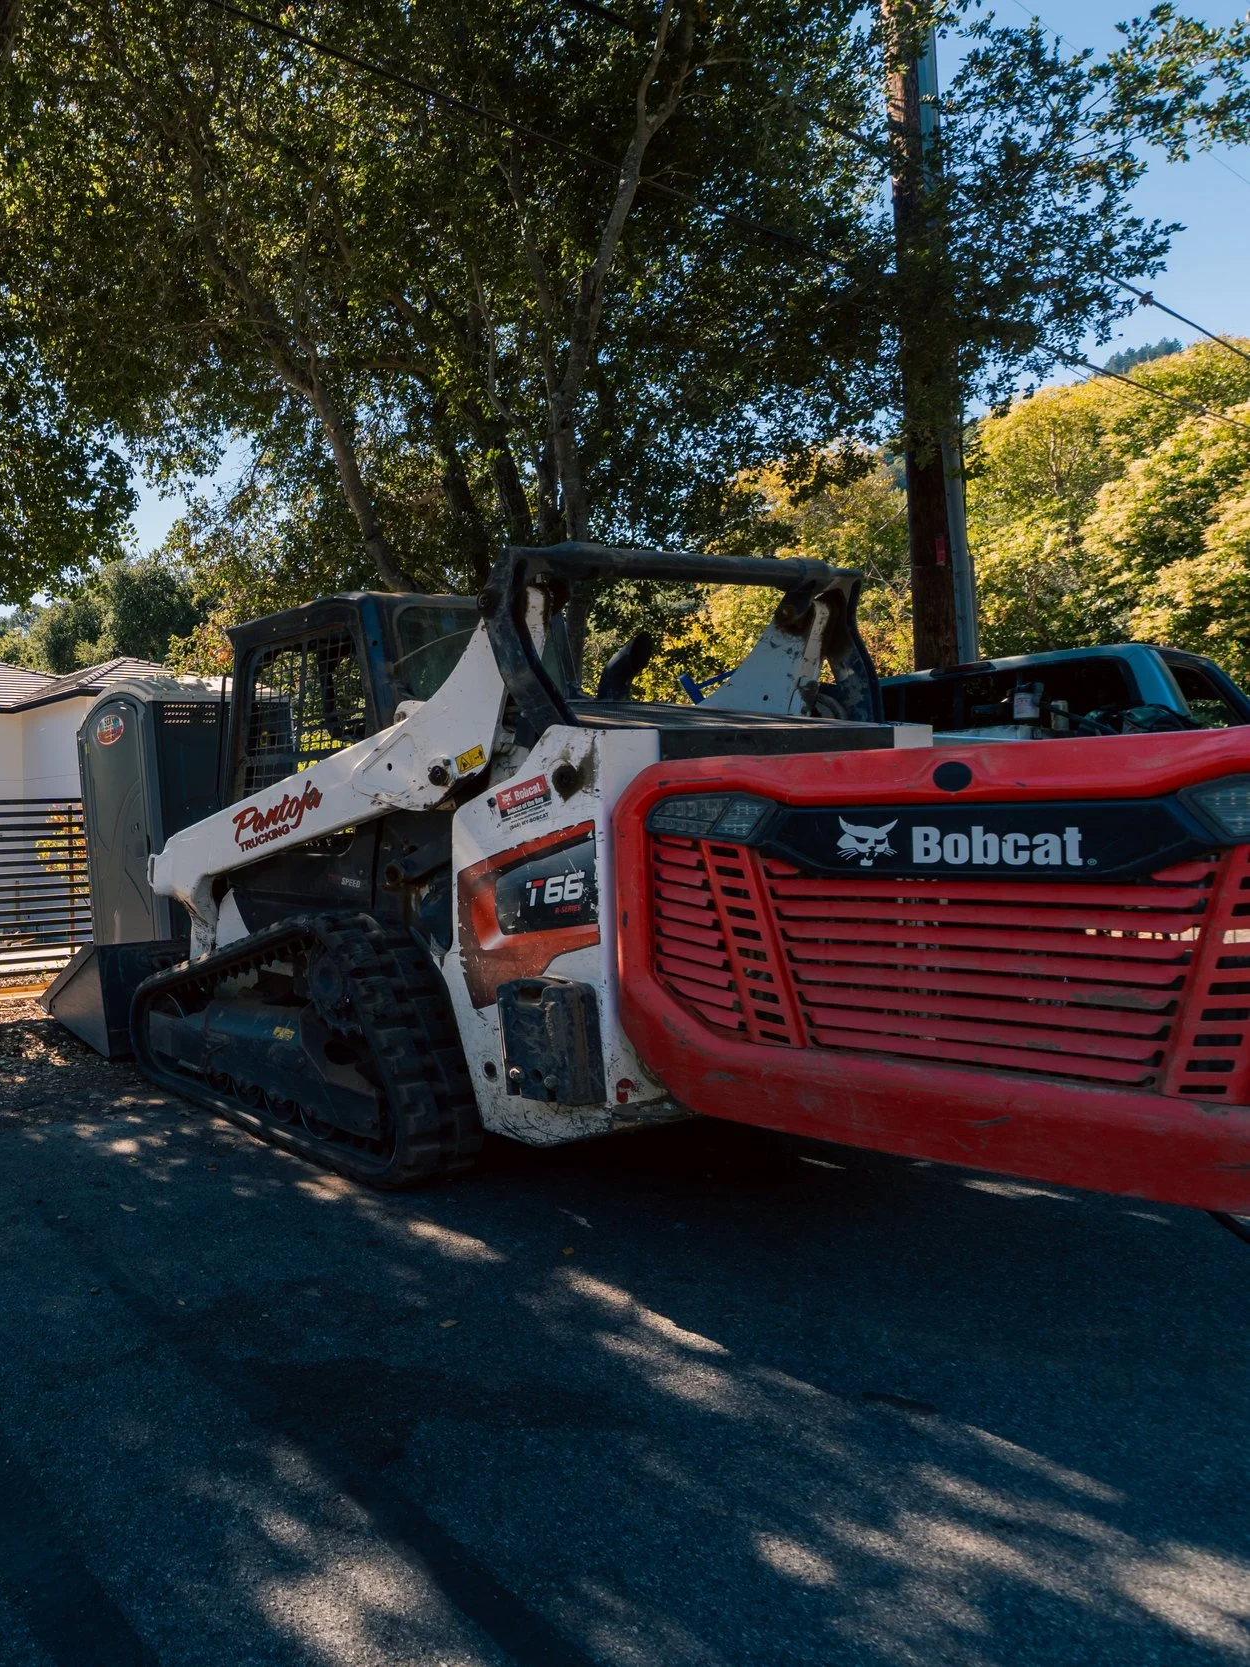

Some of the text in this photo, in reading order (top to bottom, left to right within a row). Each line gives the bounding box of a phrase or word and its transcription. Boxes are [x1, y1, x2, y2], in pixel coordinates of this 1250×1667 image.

[514, 782, 541, 801] Bobcat
[232, 780, 323, 843] Pantoja
[238, 824, 290, 852] TRUCKING
[912, 825, 1083, 866] Bobcat
[341, 877, 361, 888] SPEED
[525, 871, 585, 907] T66
